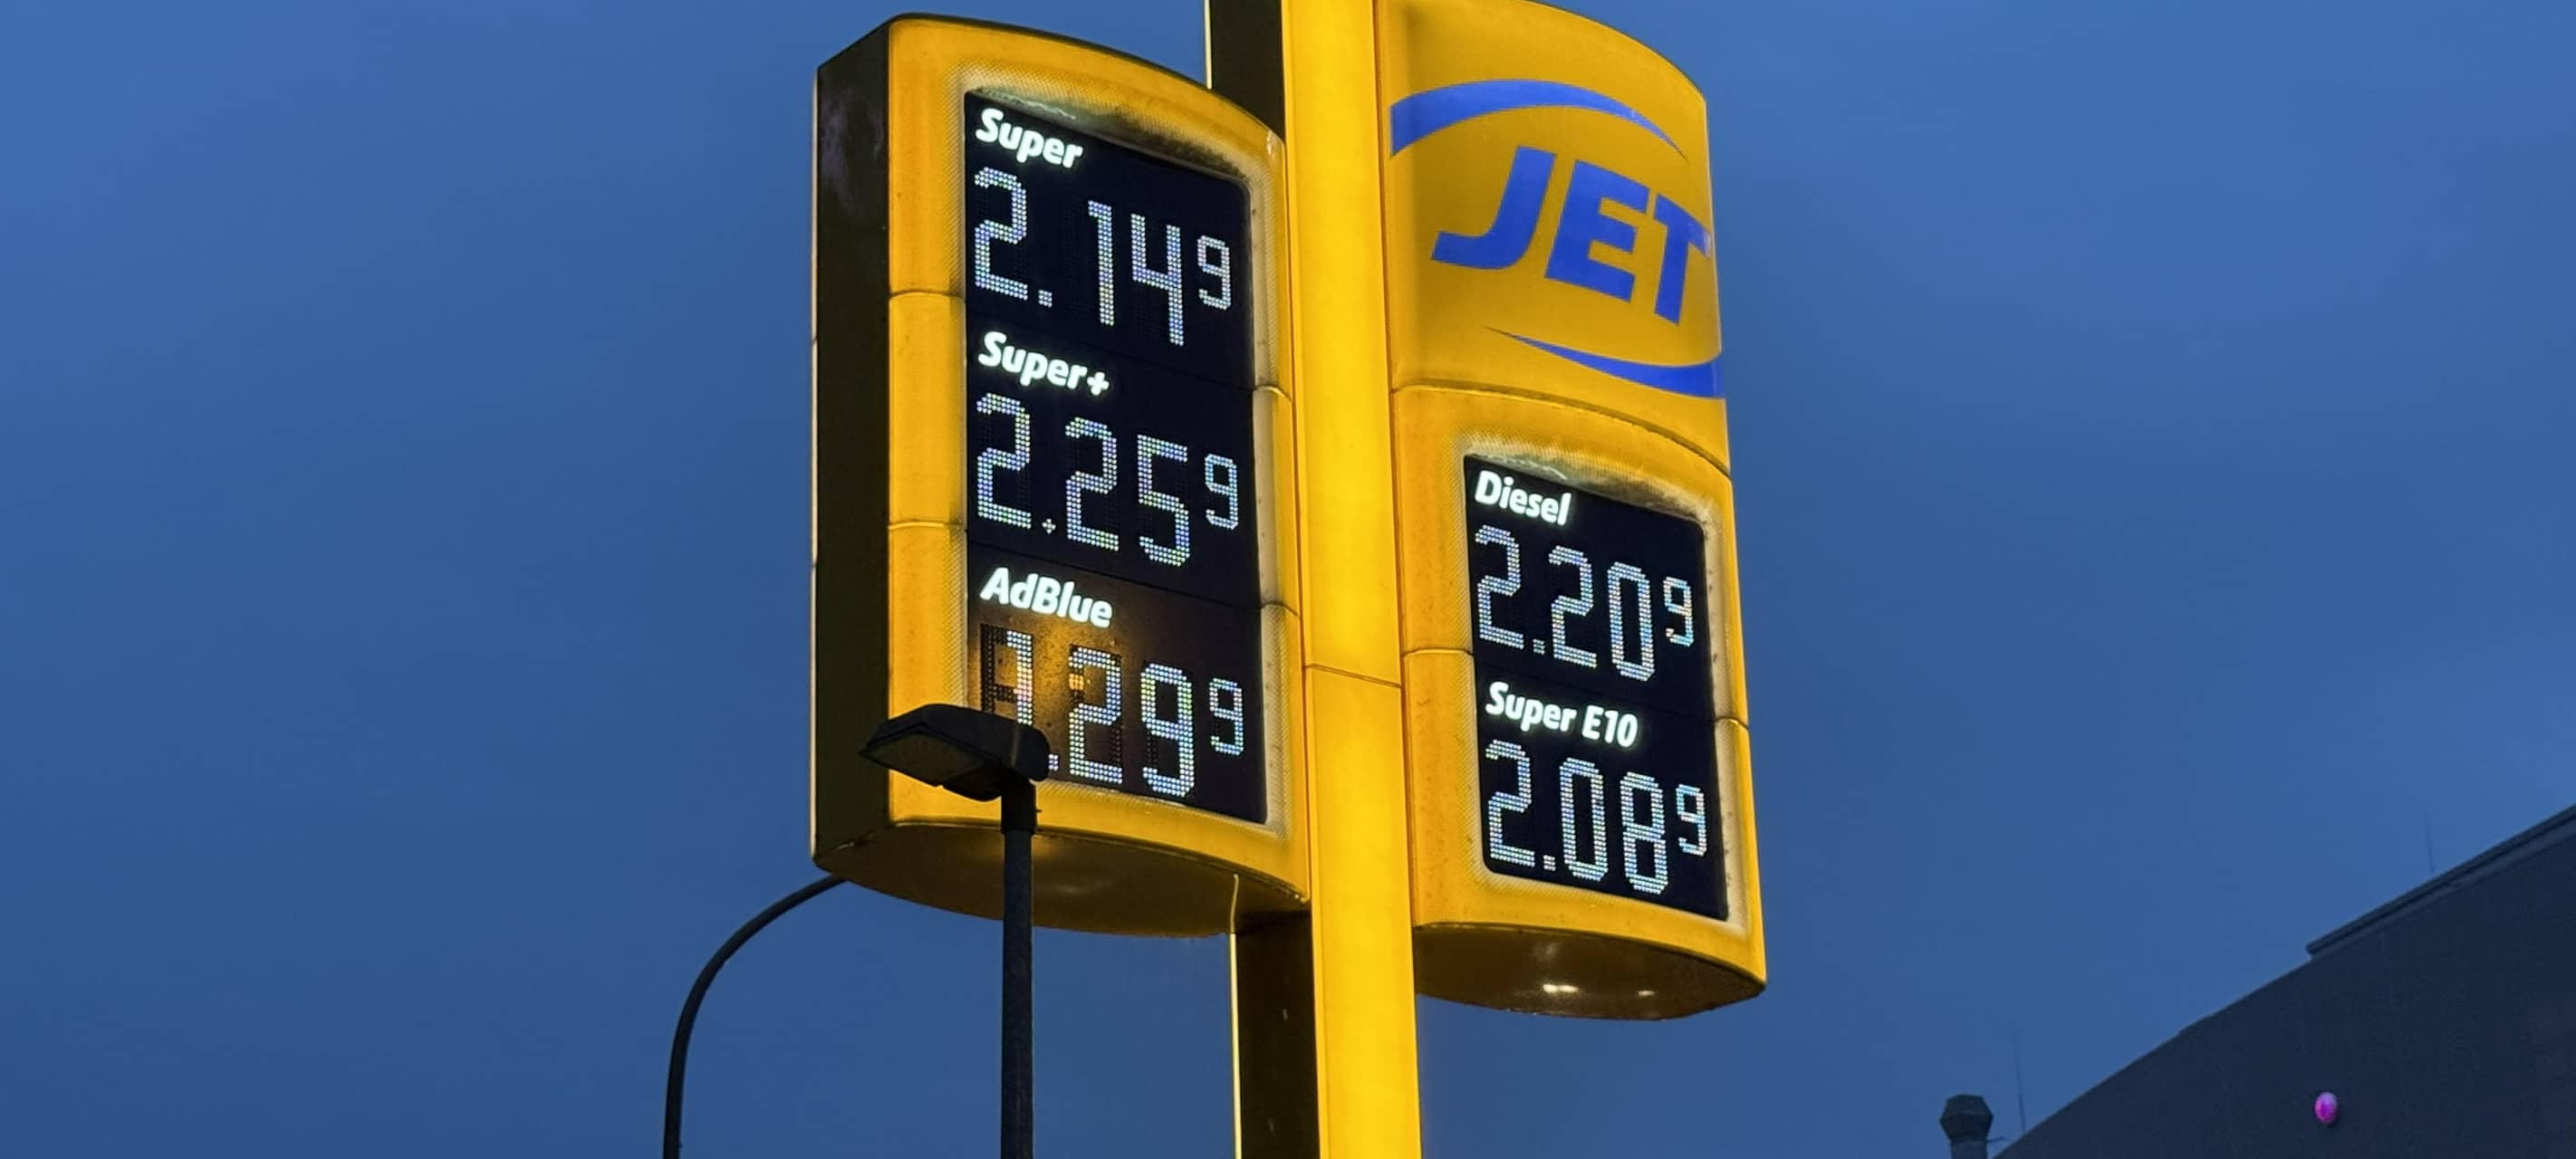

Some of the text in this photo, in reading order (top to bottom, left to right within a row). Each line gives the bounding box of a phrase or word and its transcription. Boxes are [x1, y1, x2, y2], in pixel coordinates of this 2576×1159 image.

[976, 108, 1083, 168] Super
[1431, 144, 1711, 326] JET
[977, 330, 1110, 396] Super+
[1475, 470, 1572, 526] Diesel
[979, 567, 1113, 628] AdBlue
[1485, 681, 1639, 748] Super E10
